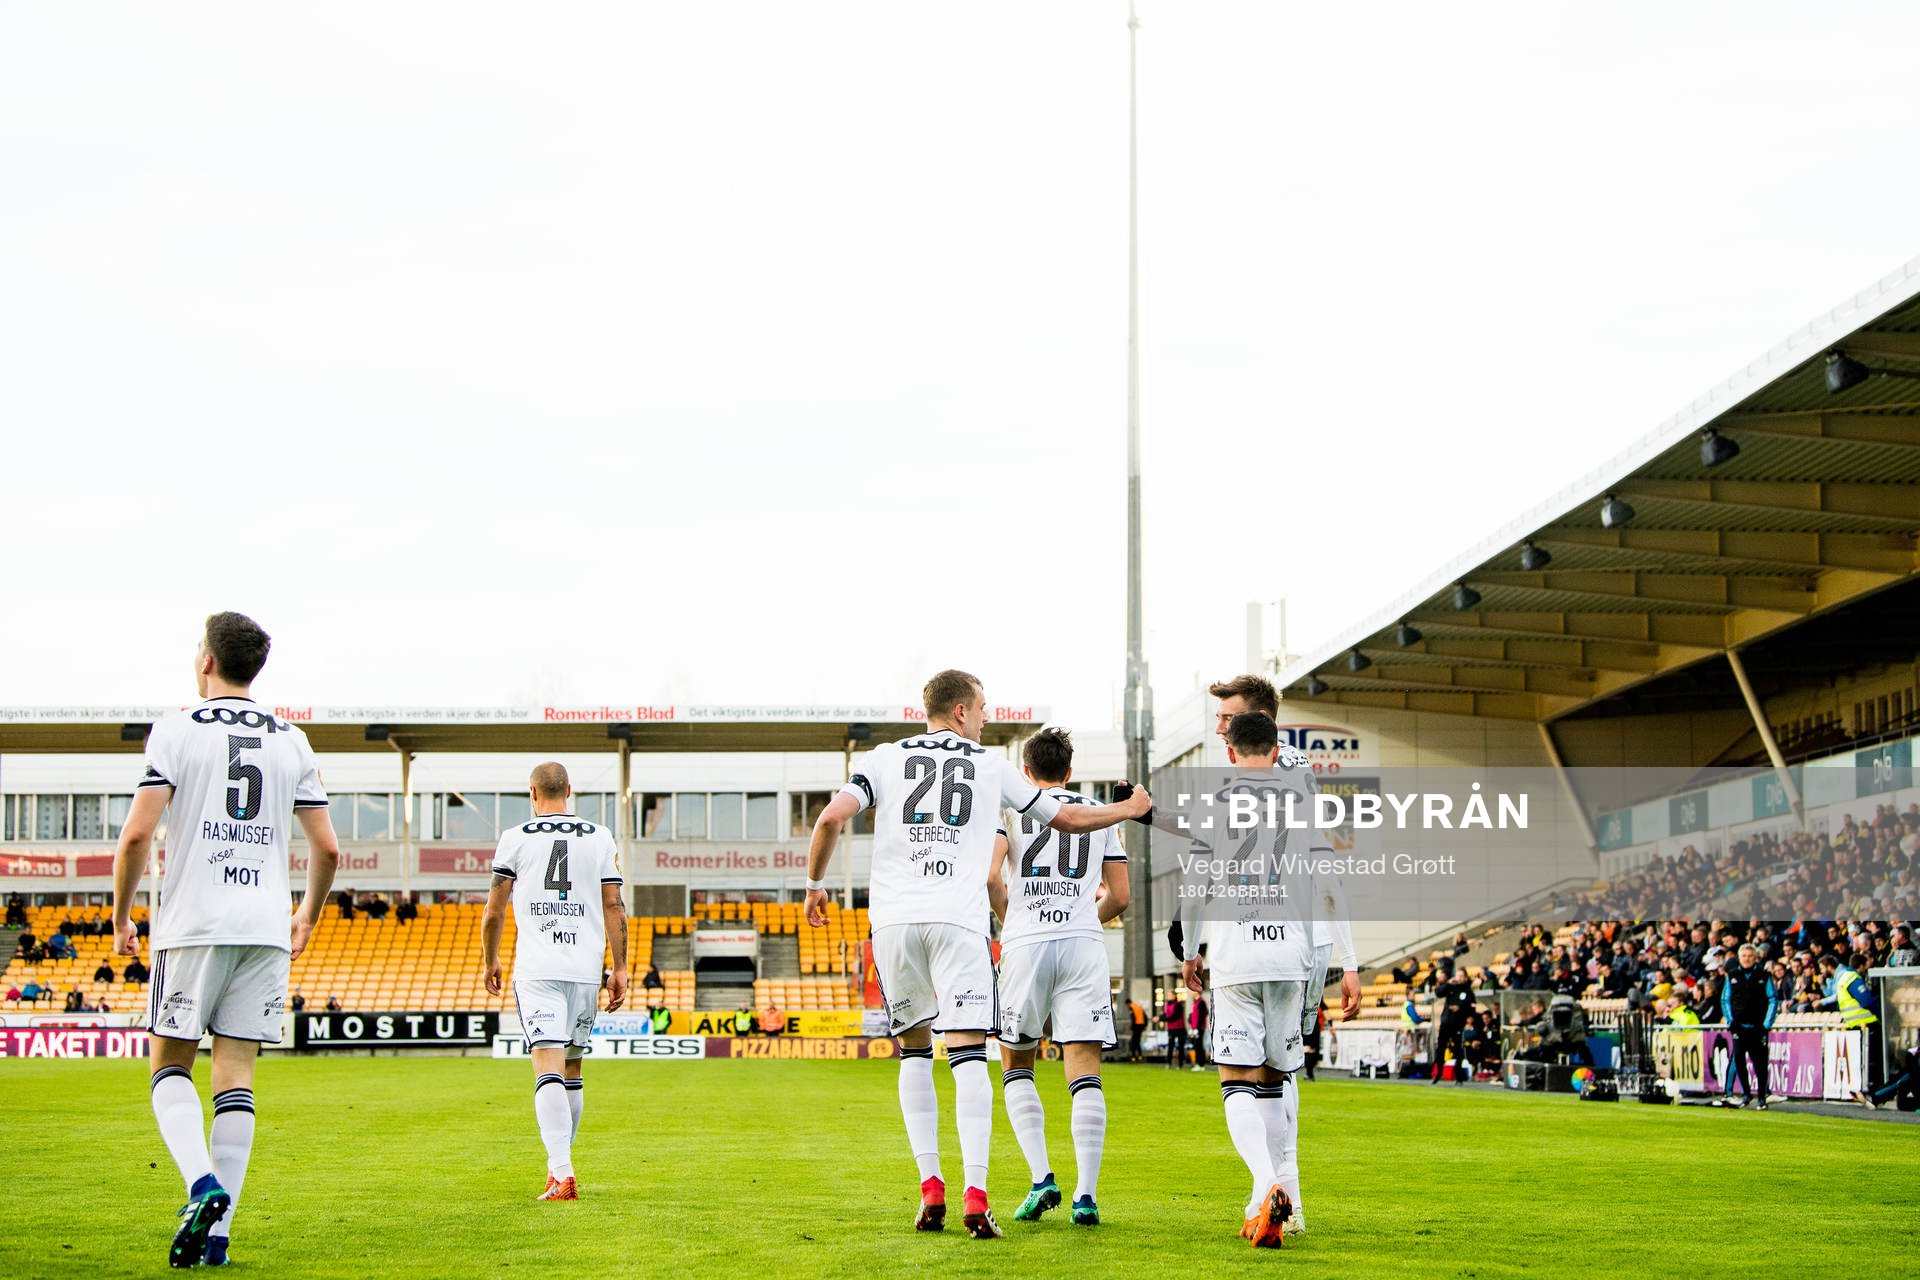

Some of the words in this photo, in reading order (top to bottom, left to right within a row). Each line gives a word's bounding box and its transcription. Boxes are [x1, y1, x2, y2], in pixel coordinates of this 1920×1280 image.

[191, 707, 290, 733] coop
[544, 706, 632, 720] Romerikes
[637, 705, 675, 720] Blad
[995, 706, 1033, 721] Blad
[226, 734, 262, 821] 5
[903, 755, 975, 827] 26
[522, 822, 596, 837] coop
[909, 826, 960, 844] SERBECIC
[1021, 814, 1091, 879] 20
[1226, 811, 1289, 887] 27
[7, 858, 63, 876] rb.no
[656, 851, 767, 868] Romerikes
[773, 851, 808, 868] Bla
[224, 866, 260, 887] MOT
[544, 840, 572, 900] 4
[923, 861, 953, 877] MOT
[1024, 881, 1080, 897] AMUNDSEN
[1040, 909, 1071, 923] MOT
[553, 931, 577, 945] MOT
[1253, 925, 1285, 940] MOT
[308, 1016, 487, 1039] MOSTUE
[14, 1031, 101, 1058] TAKET
[605, 1039, 700, 1055] TESS
[731, 1039, 859, 1059] PIZZABAKEREN
